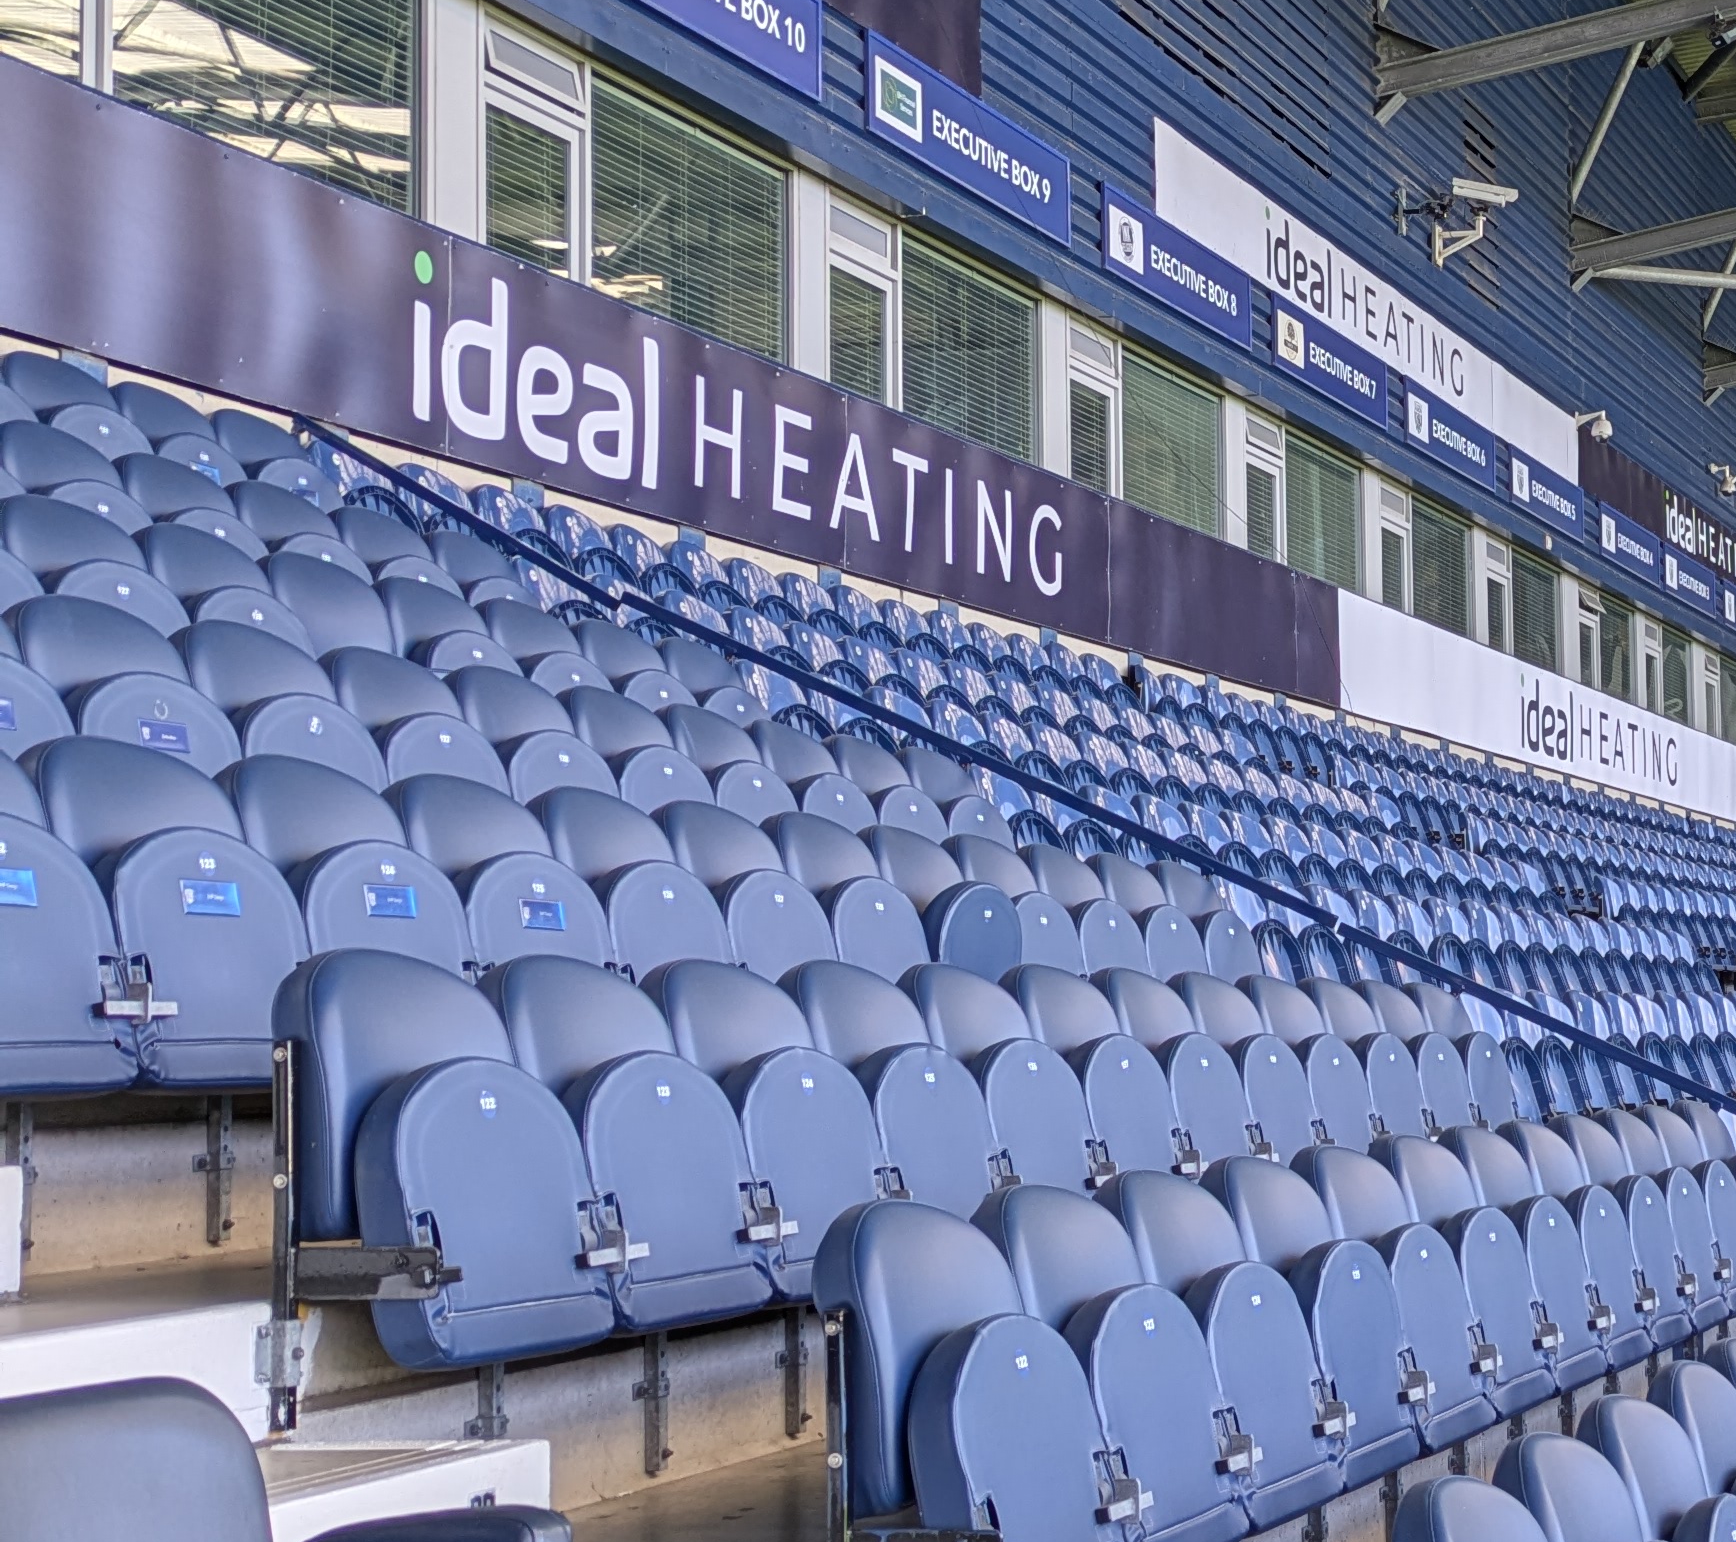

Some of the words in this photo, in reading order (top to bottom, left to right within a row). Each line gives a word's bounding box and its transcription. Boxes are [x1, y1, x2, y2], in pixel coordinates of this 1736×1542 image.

[783, 17, 806, 53] 10
[932, 109, 1009, 181] EXECUTIVE
[1010, 160, 1039, 198] BOX
[1041, 179, 1051, 204] 9
[1150, 243, 1207, 299] EXECUTIVE
[1208, 279, 1230, 313] BOX
[1230, 294, 1238, 317] 8
[1265, 206, 1333, 320] ideal
[1341, 268, 1465, 397] HEATING
[1309, 342, 1353, 390] EXECUTIVE
[1353, 364, 1371, 398] BOX
[1371, 380, 1377, 400] 7
[413, 250, 659, 490] ideal
[694, 374, 1062, 596] HEATING
[1432, 418, 1467, 456] EXECUTIVE
[1467, 438, 1480, 465] BOX
[1481, 448, 1486, 467] 6
[1531, 479, 1560, 513] EXECUTIVE
[1560, 496, 1571, 518] BOX
[1571, 504, 1576, 521] 5
[1665, 490, 1696, 555] ideal
[1617, 532, 1641, 560] EXECUTIVE
[1520, 673, 1575, 763] ideal
[1579, 703, 1679, 787] HEATING
[198, 858, 216, 870] 123
[479, 1096, 497, 1110] 122
[656, 1085, 671, 1097] 123
